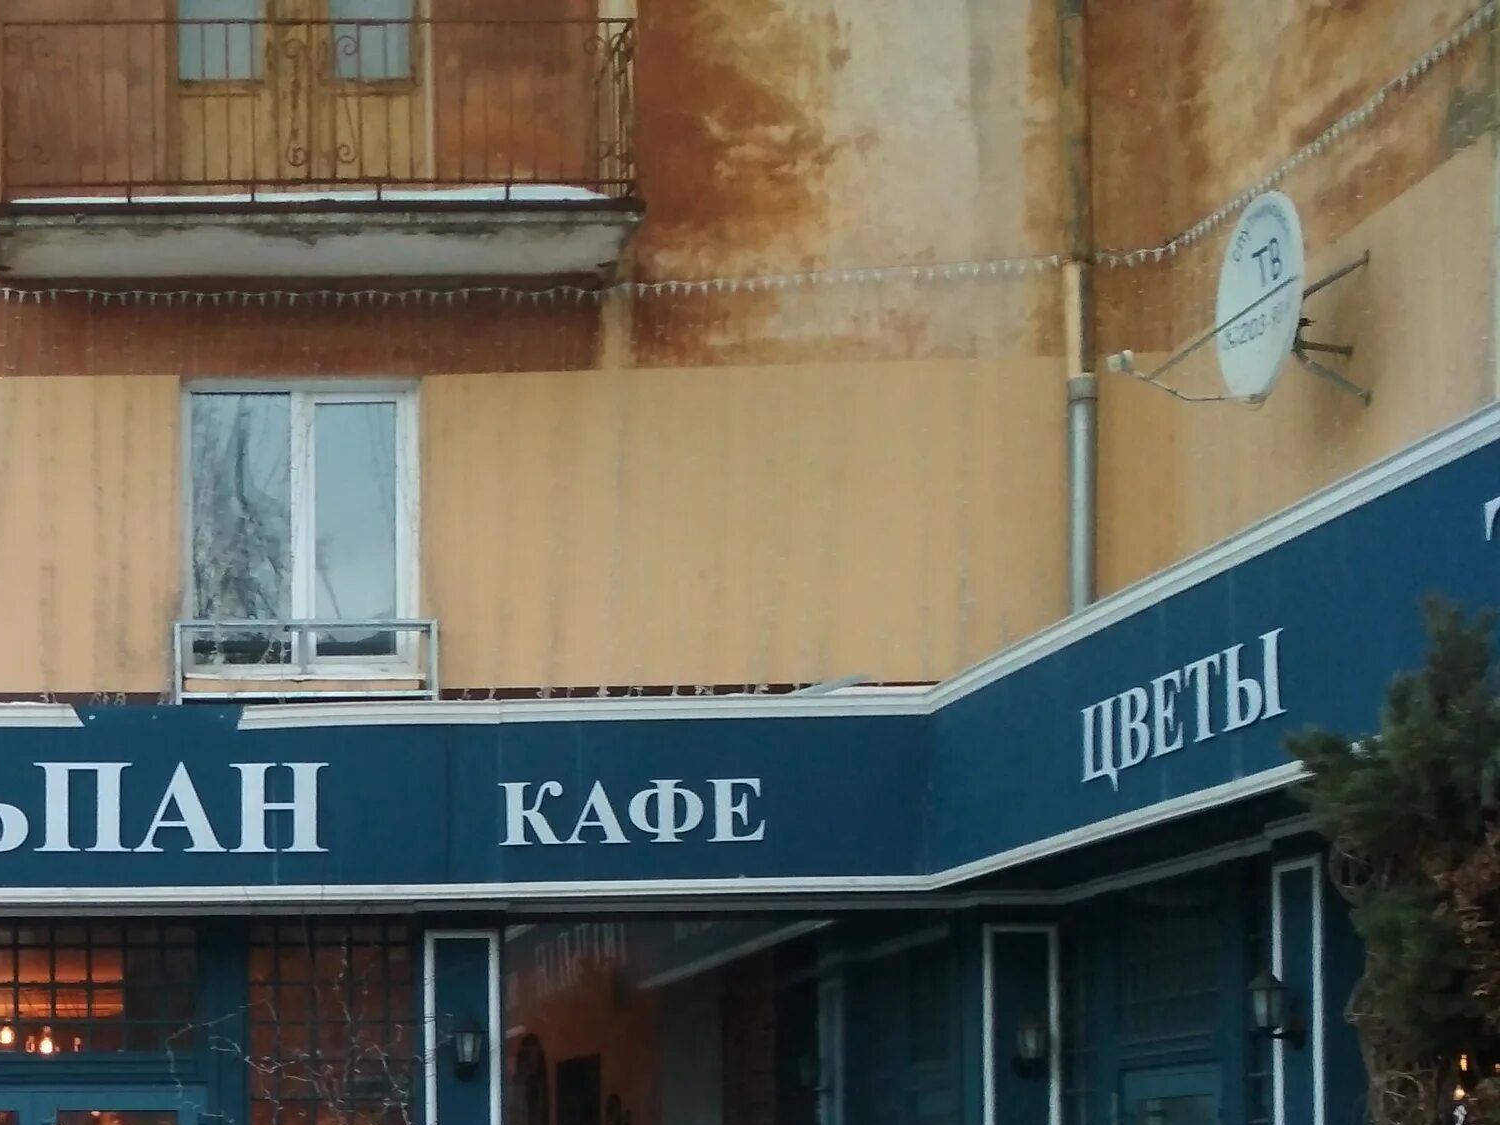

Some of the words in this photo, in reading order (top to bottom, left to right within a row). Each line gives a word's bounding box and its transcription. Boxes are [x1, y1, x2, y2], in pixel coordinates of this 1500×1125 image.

[1252, 238, 1283, 287] ТВ
[1080, 627, 1287, 791] ЦВЕТЫ
[498, 777, 766, 847] КАФЕ
